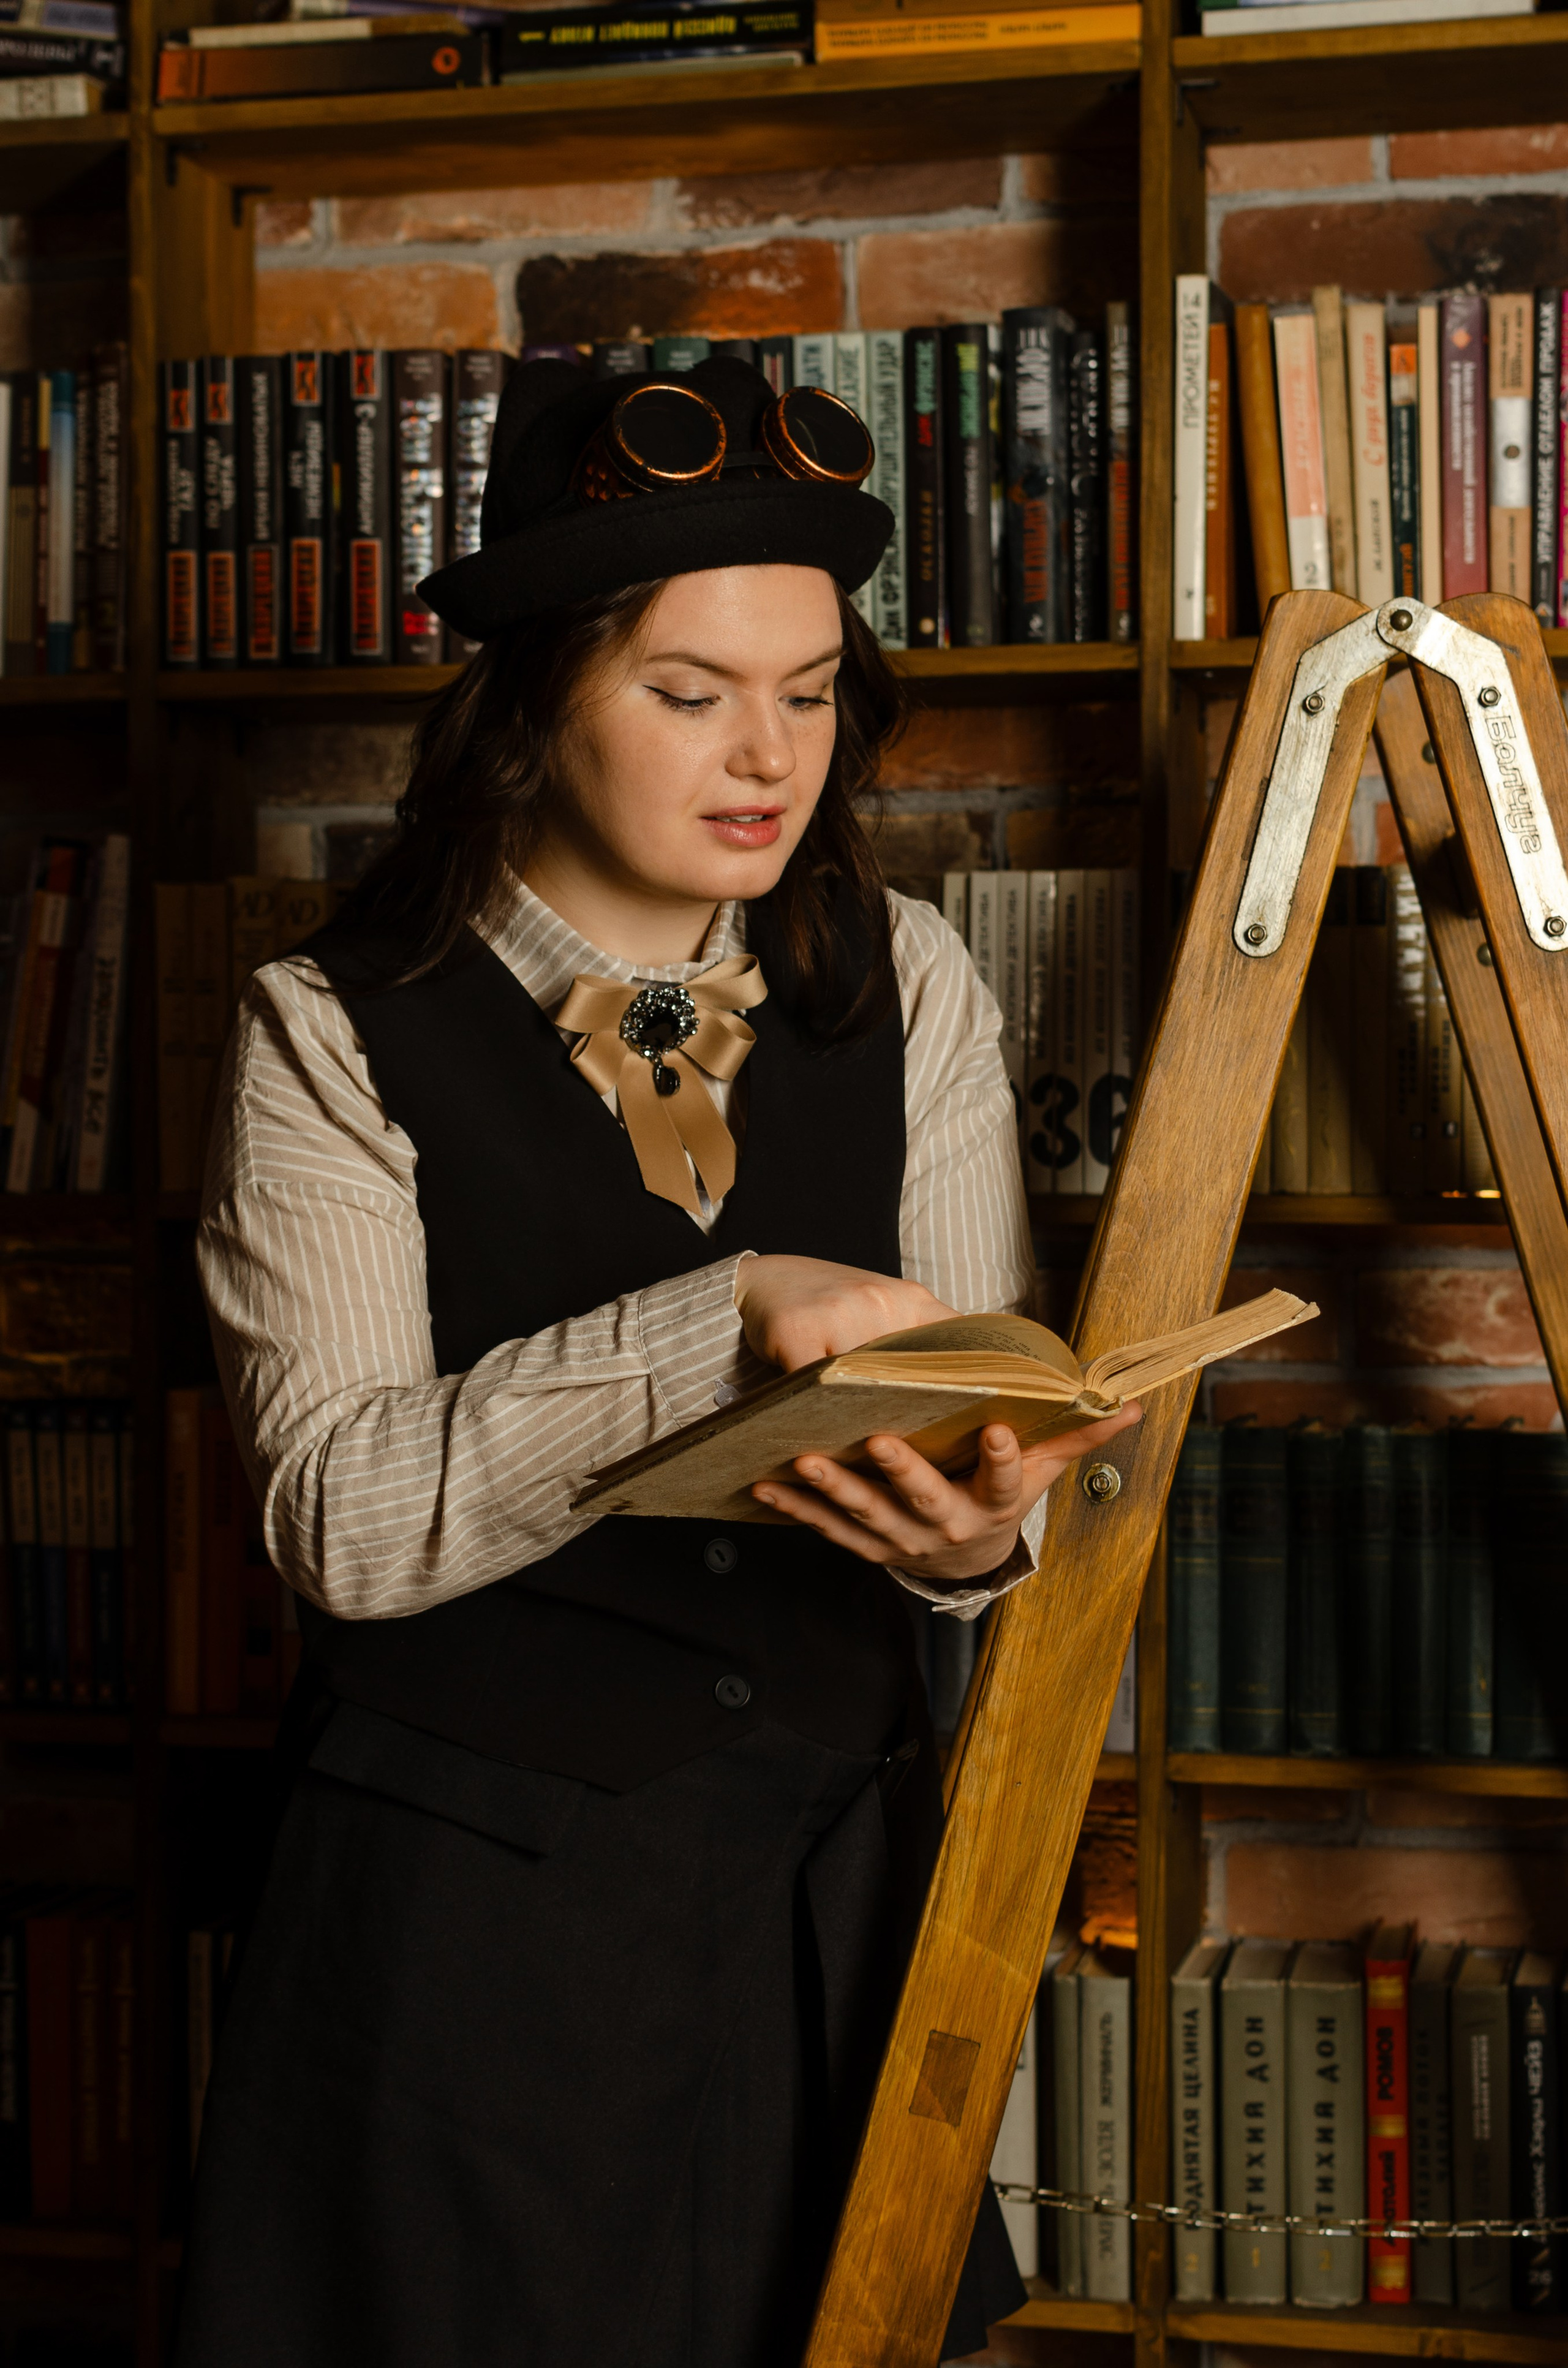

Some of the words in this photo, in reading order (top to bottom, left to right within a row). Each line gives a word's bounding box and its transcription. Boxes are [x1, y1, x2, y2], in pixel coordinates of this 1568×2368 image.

[1182, 311, 1201, 428] ПРОМЕТЕЙ
[1538, 301, 1556, 374] ПРОДАЖ
[1537, 378, 1555, 455] ОТДЕЛОМ
[1537, 457, 1555, 564] УПРАВЛЕНИЕ
[880, 530, 899, 604] ФРЭНС
[1485, 715, 1542, 855] Балчуг
[1009, 1072, 1134, 1170] 36
[1182, 2008, 1202, 2098] ЦЕЛИНА
[1245, 2016, 1269, 2082] ДОН
[1316, 2016, 1339, 2083] ДОН
[1377, 2027, 1395, 2101] РОМОВ
[1524, 2039, 1543, 2096] ЧЕЙЗ
[1245, 2101, 1266, 2215] ТИХИЙ
[1314, 2101, 1336, 2215] ТИХИЙ
[1415, 2117, 1431, 2246] ЖЛЕЗНЫЙ
[1098, 2185, 1115, 2260] ЭМИЬ
